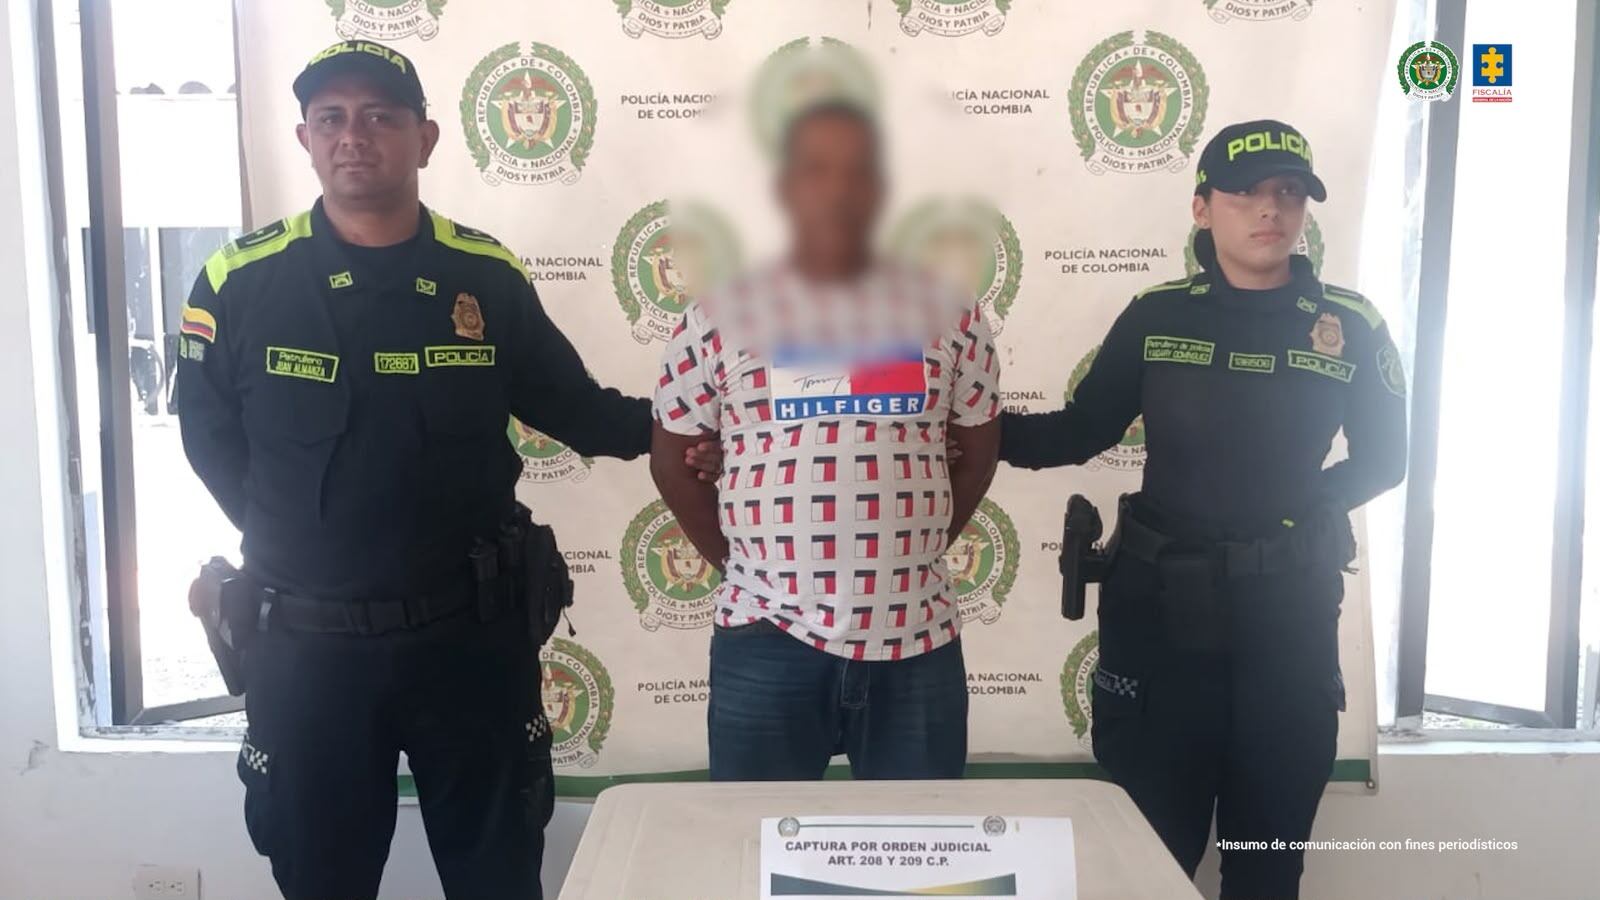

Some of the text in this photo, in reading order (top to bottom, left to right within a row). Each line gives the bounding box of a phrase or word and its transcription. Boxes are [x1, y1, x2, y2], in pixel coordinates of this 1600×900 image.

[1262, 1, 1297, 17] PATRIA
[387, 15, 423, 32] PATRIA
[672, 15, 707, 30] PATRIA
[954, 10, 990, 28] PATRIA
[1132, 46, 1148, 56] DE
[1157, 53, 1192, 110] COLOMBIA
[520, 58, 536, 68] DE
[546, 64, 582, 123] COLOMBIA
[981, 89, 1050, 100] NACIONAL
[621, 92, 720, 105] POLICÍA NACIO
[638, 109, 654, 119] DE
[964, 104, 1033, 115] COLOMBIA
[1137, 121, 1187, 156] NACIONAL
[530, 133, 578, 169] NACIONAL
[1137, 153, 1174, 170] PATRIA
[531, 165, 566, 182] PATRIA
[1044, 247, 1168, 260] POLICÍA NACIONAL
[535, 257, 604, 267] NACIONAL
[1061, 262, 1150, 274] DE COLOMBIA
[530, 271, 587, 281] OLOMBIA
[780, 397, 920, 420] HILFIGER
[541, 464, 576, 480] PATRIA
[542, 651, 599, 709] DE COLOMBIA
[978, 673, 1043, 682] NACIONAL
[637, 679, 686, 692] POLICÍA
[654, 694, 671, 704] DE
[785, 841, 992, 852] CAPTURA POR ORDEN JUDICIAL
[828, 856, 950, 866] ART. 208 Y 209 C.P.
